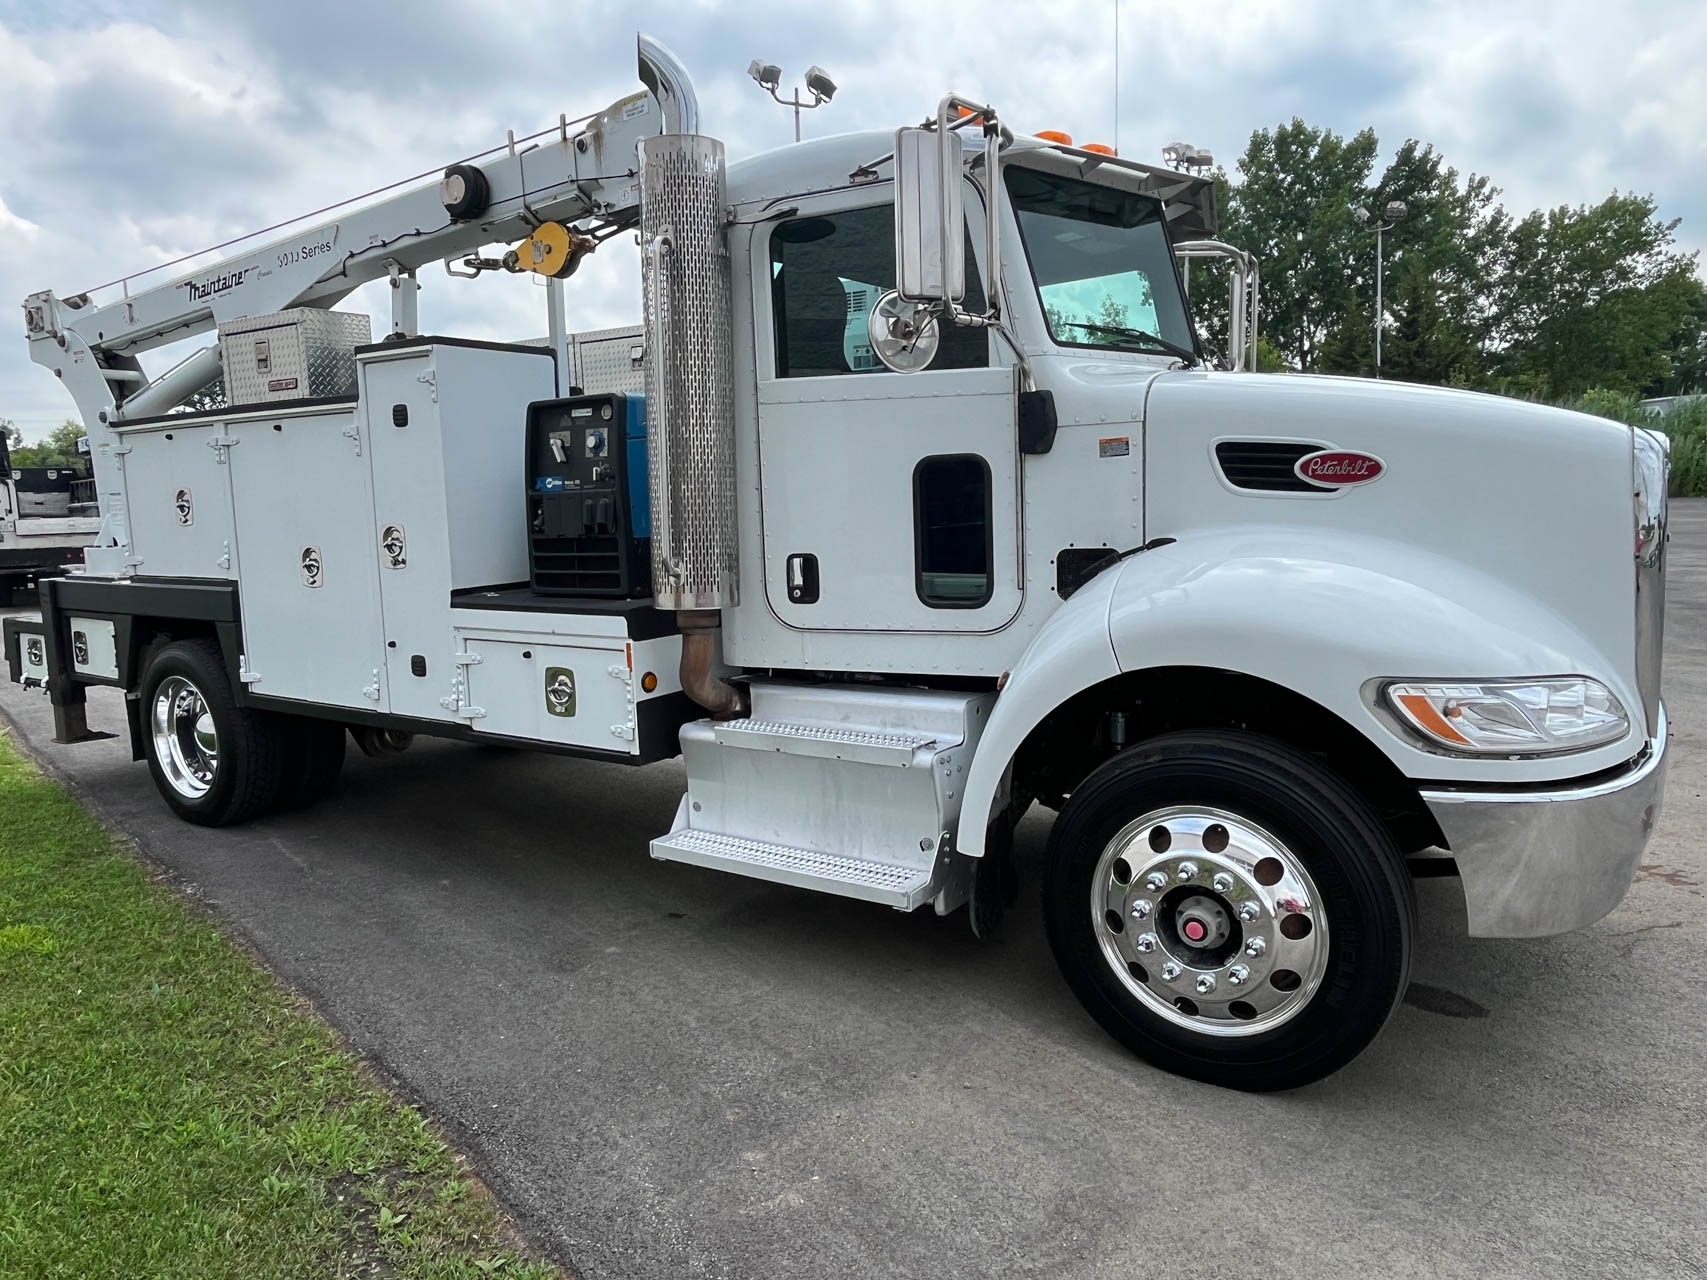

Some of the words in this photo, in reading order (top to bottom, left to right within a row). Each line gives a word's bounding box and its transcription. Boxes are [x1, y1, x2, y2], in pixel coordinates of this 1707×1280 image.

[302, 241, 332, 260] Series
[183, 269, 250, 302] Maintainer
[1308, 458, 1376, 476] Peterbilt
